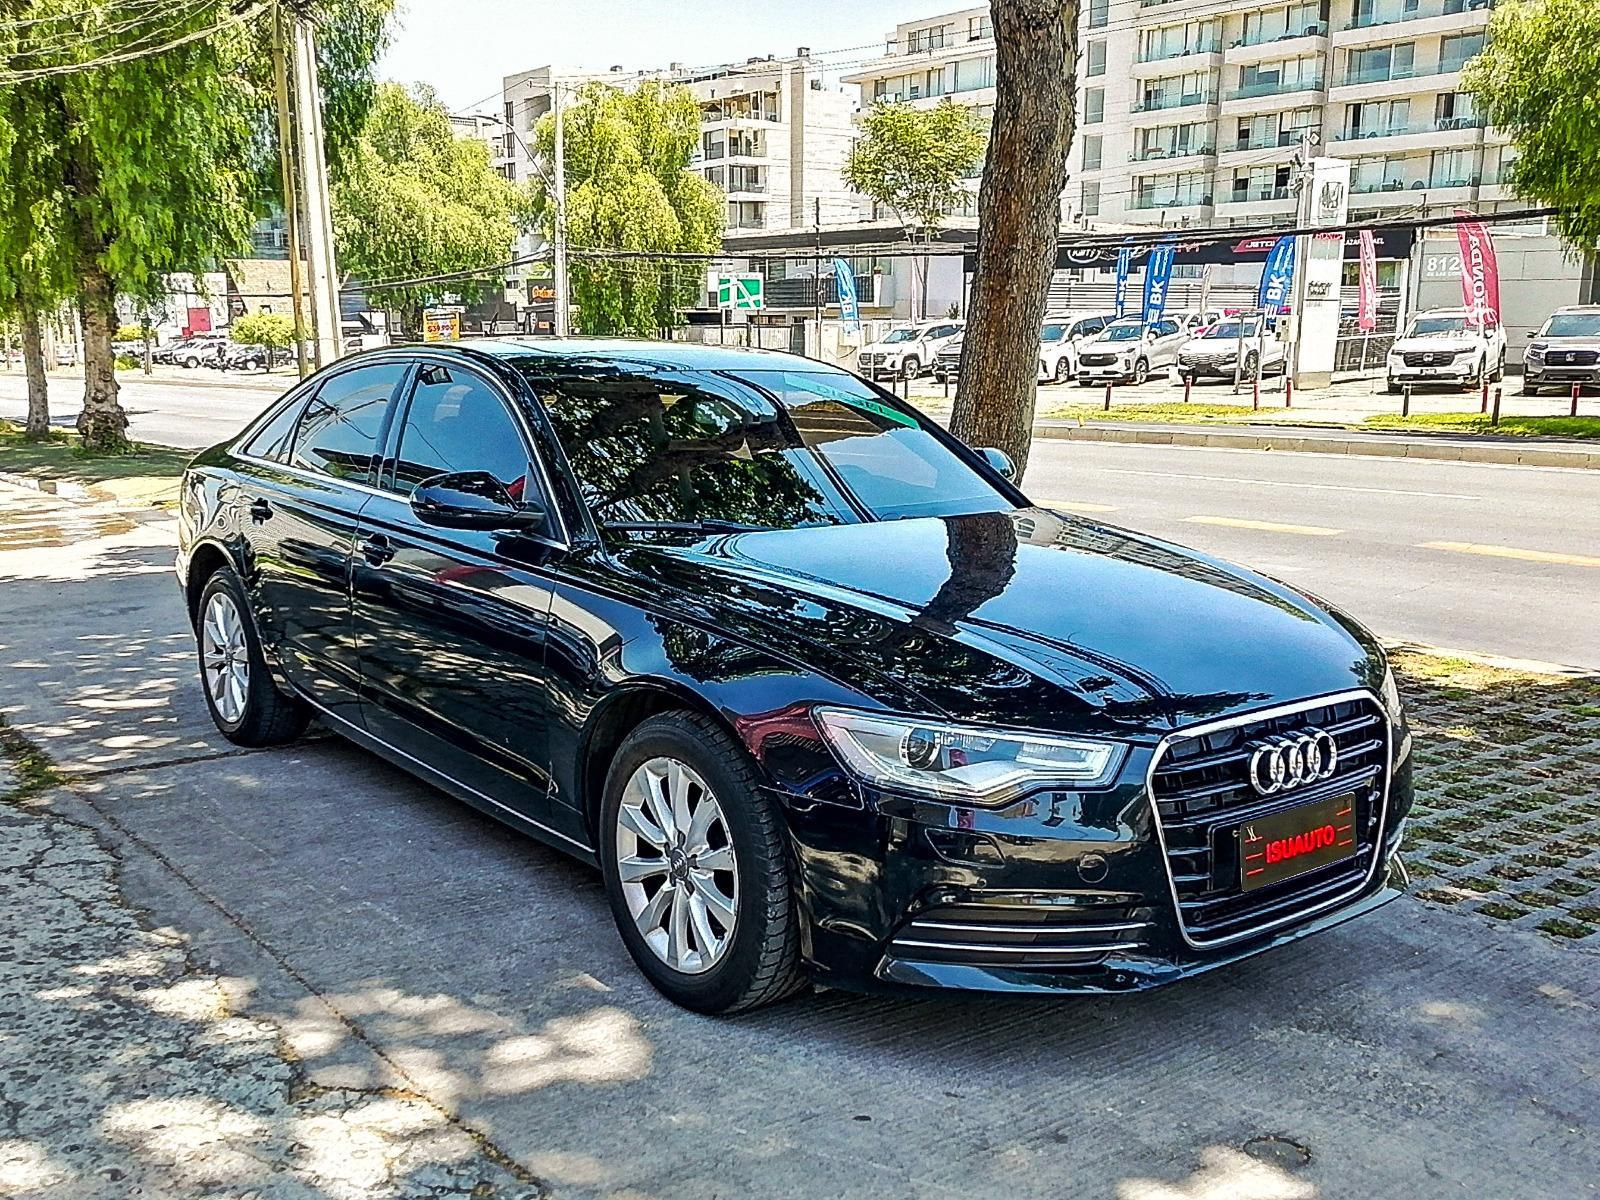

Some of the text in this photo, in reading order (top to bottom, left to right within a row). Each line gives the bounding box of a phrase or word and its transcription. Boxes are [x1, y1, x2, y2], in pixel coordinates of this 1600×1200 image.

[1427, 256, 1462, 271] 812
[1468, 235, 1485, 312] HONDA
[1149, 279, 1165, 305] BK
[1265, 273, 1287, 301] BK
[1265, 825, 1336, 864] ISUAUTO
